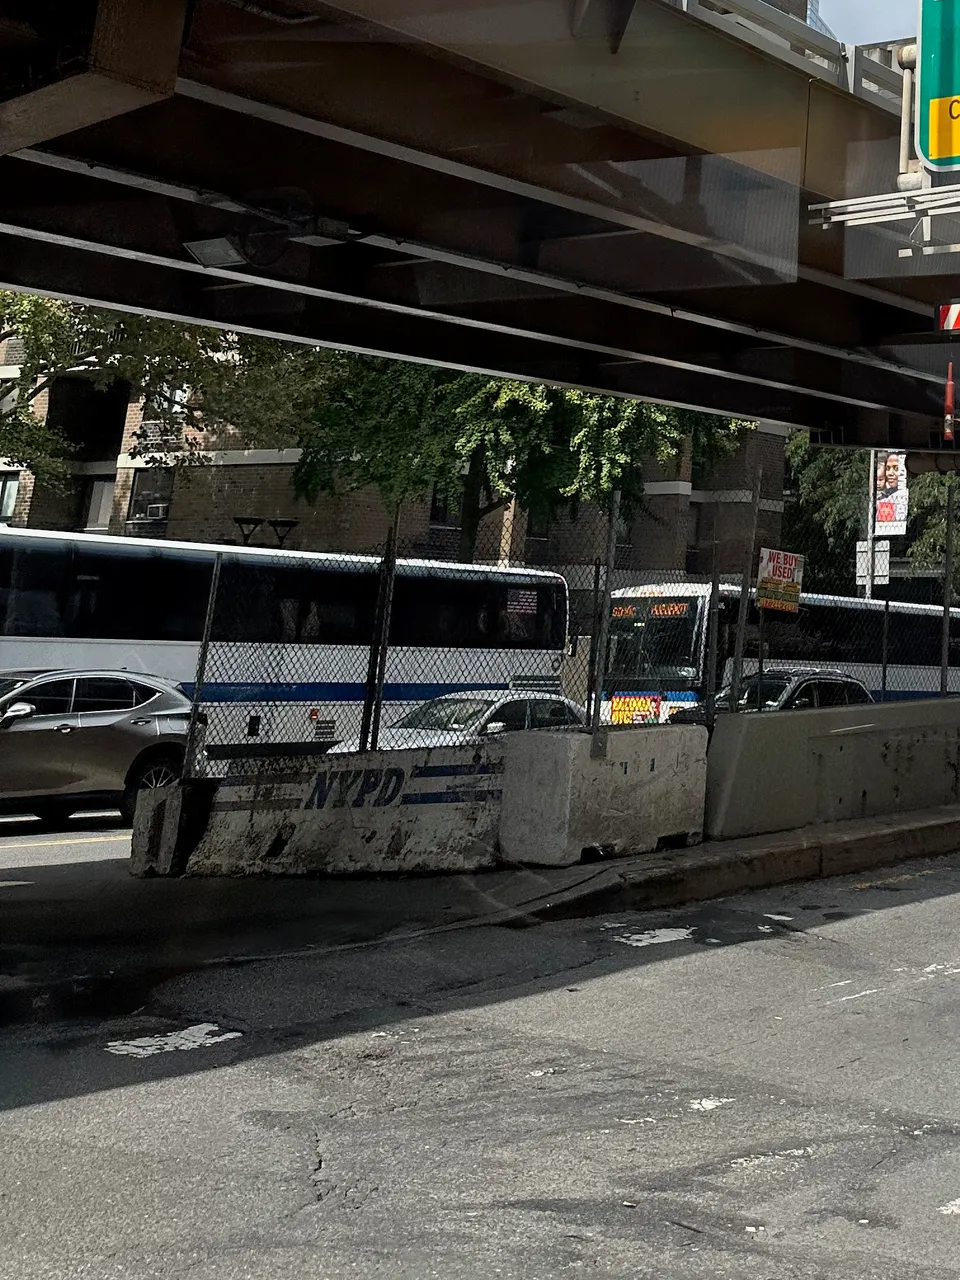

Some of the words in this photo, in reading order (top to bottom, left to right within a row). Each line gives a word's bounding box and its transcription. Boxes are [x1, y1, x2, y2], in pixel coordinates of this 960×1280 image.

[768, 551, 782, 564] WE
[783, 553, 799, 567] BUY
[772, 564, 793, 579] USED
[304, 767, 405, 810] NYPD
